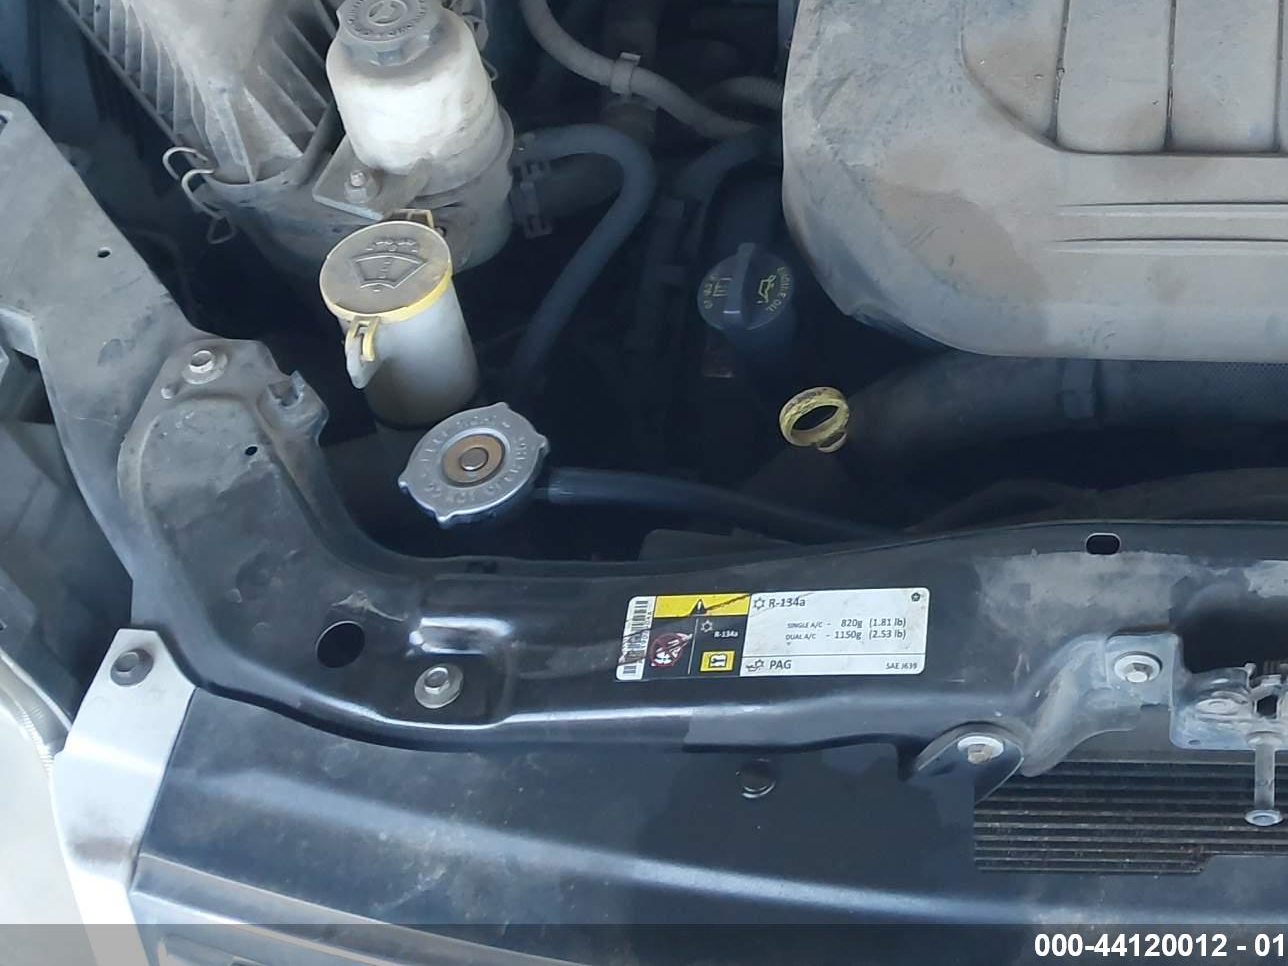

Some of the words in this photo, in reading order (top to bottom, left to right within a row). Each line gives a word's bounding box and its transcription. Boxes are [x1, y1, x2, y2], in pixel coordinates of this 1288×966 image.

[767, 597, 806, 608] R-134a
[810, 621, 823, 629] A/C
[840, 619, 863, 629] 820g
[869, 617, 892, 627] (1.81
[893, 617, 907, 628] lb)
[714, 630, 739, 638] R-134a
[834, 630, 862, 640] 1150g
[868, 629, 892, 640] (2.53
[893, 629, 907, 639] lb)
[769, 659, 792, 671] PAG
[886, 662, 900, 670] SAE
[901, 662, 918, 670] J639
